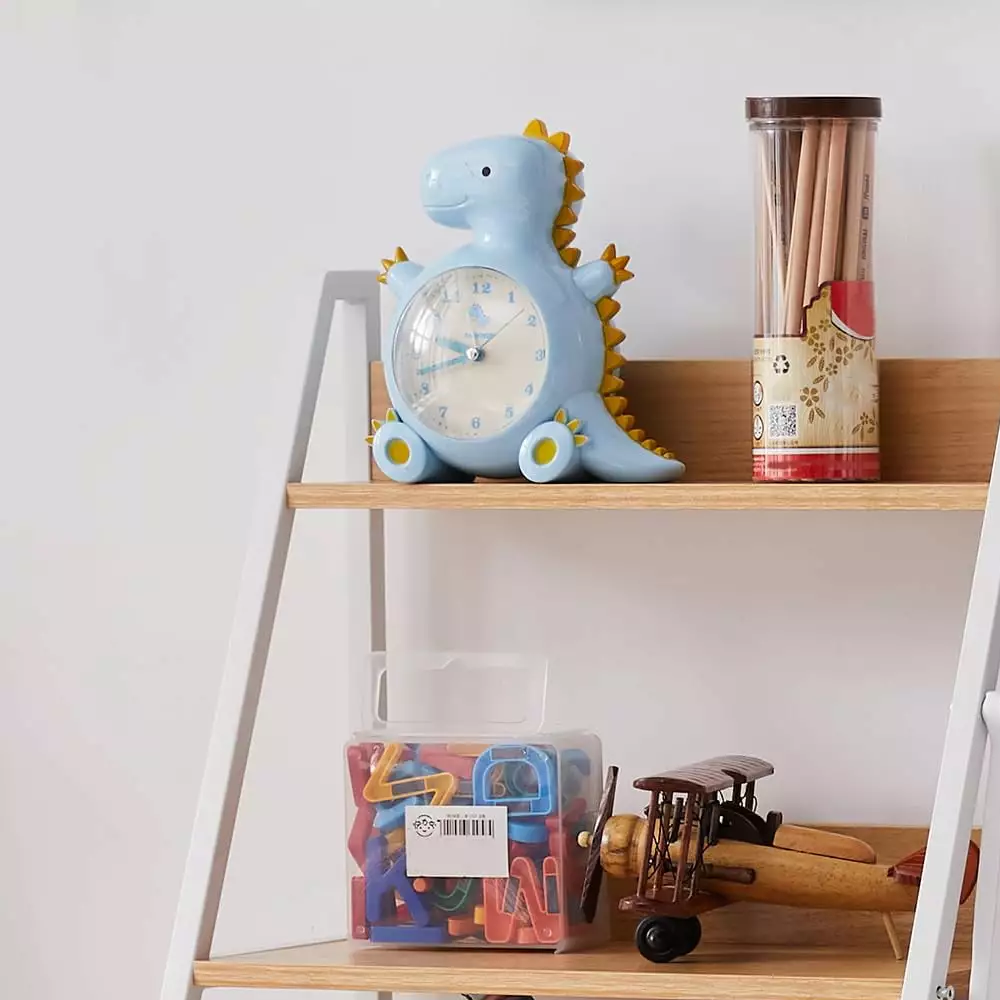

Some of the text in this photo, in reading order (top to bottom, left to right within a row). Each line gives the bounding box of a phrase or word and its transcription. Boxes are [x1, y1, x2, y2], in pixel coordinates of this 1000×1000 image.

[472, 282, 491, 294] 12
[508, 291, 515, 303] 1
[528, 315, 536, 327] 2
[535, 350, 544, 361] 3
[525, 383, 533, 395] 4
[439, 407, 447, 418] 7
[505, 407, 513, 418] 5
[472, 417, 480, 429] 6
